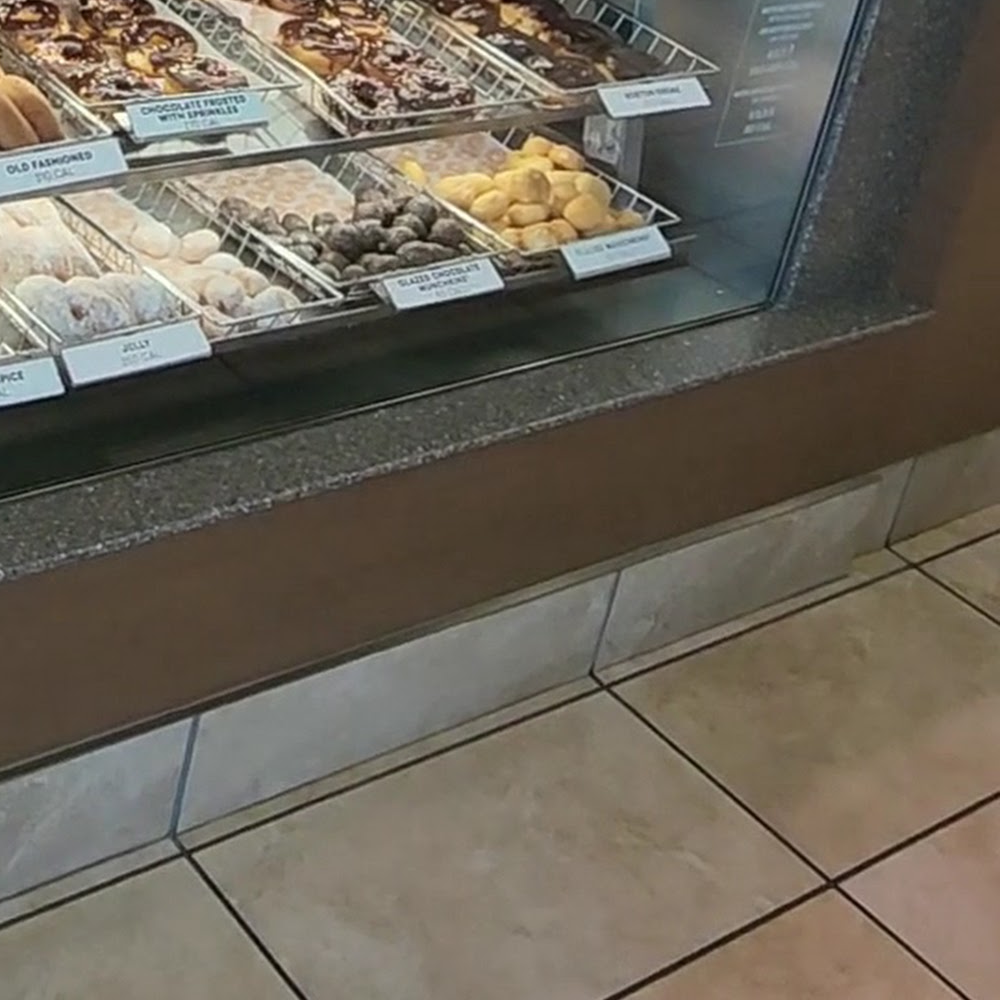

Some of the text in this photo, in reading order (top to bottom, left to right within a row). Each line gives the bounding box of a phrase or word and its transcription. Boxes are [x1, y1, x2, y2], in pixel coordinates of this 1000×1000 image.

[140, 95, 247, 116] CHOCOLATE FROSTED
[158, 105, 239, 122] WITH SPRINKLES
[6, 150, 94, 175] OLD FASHIONED
[122, 339, 150, 353] JELLY
